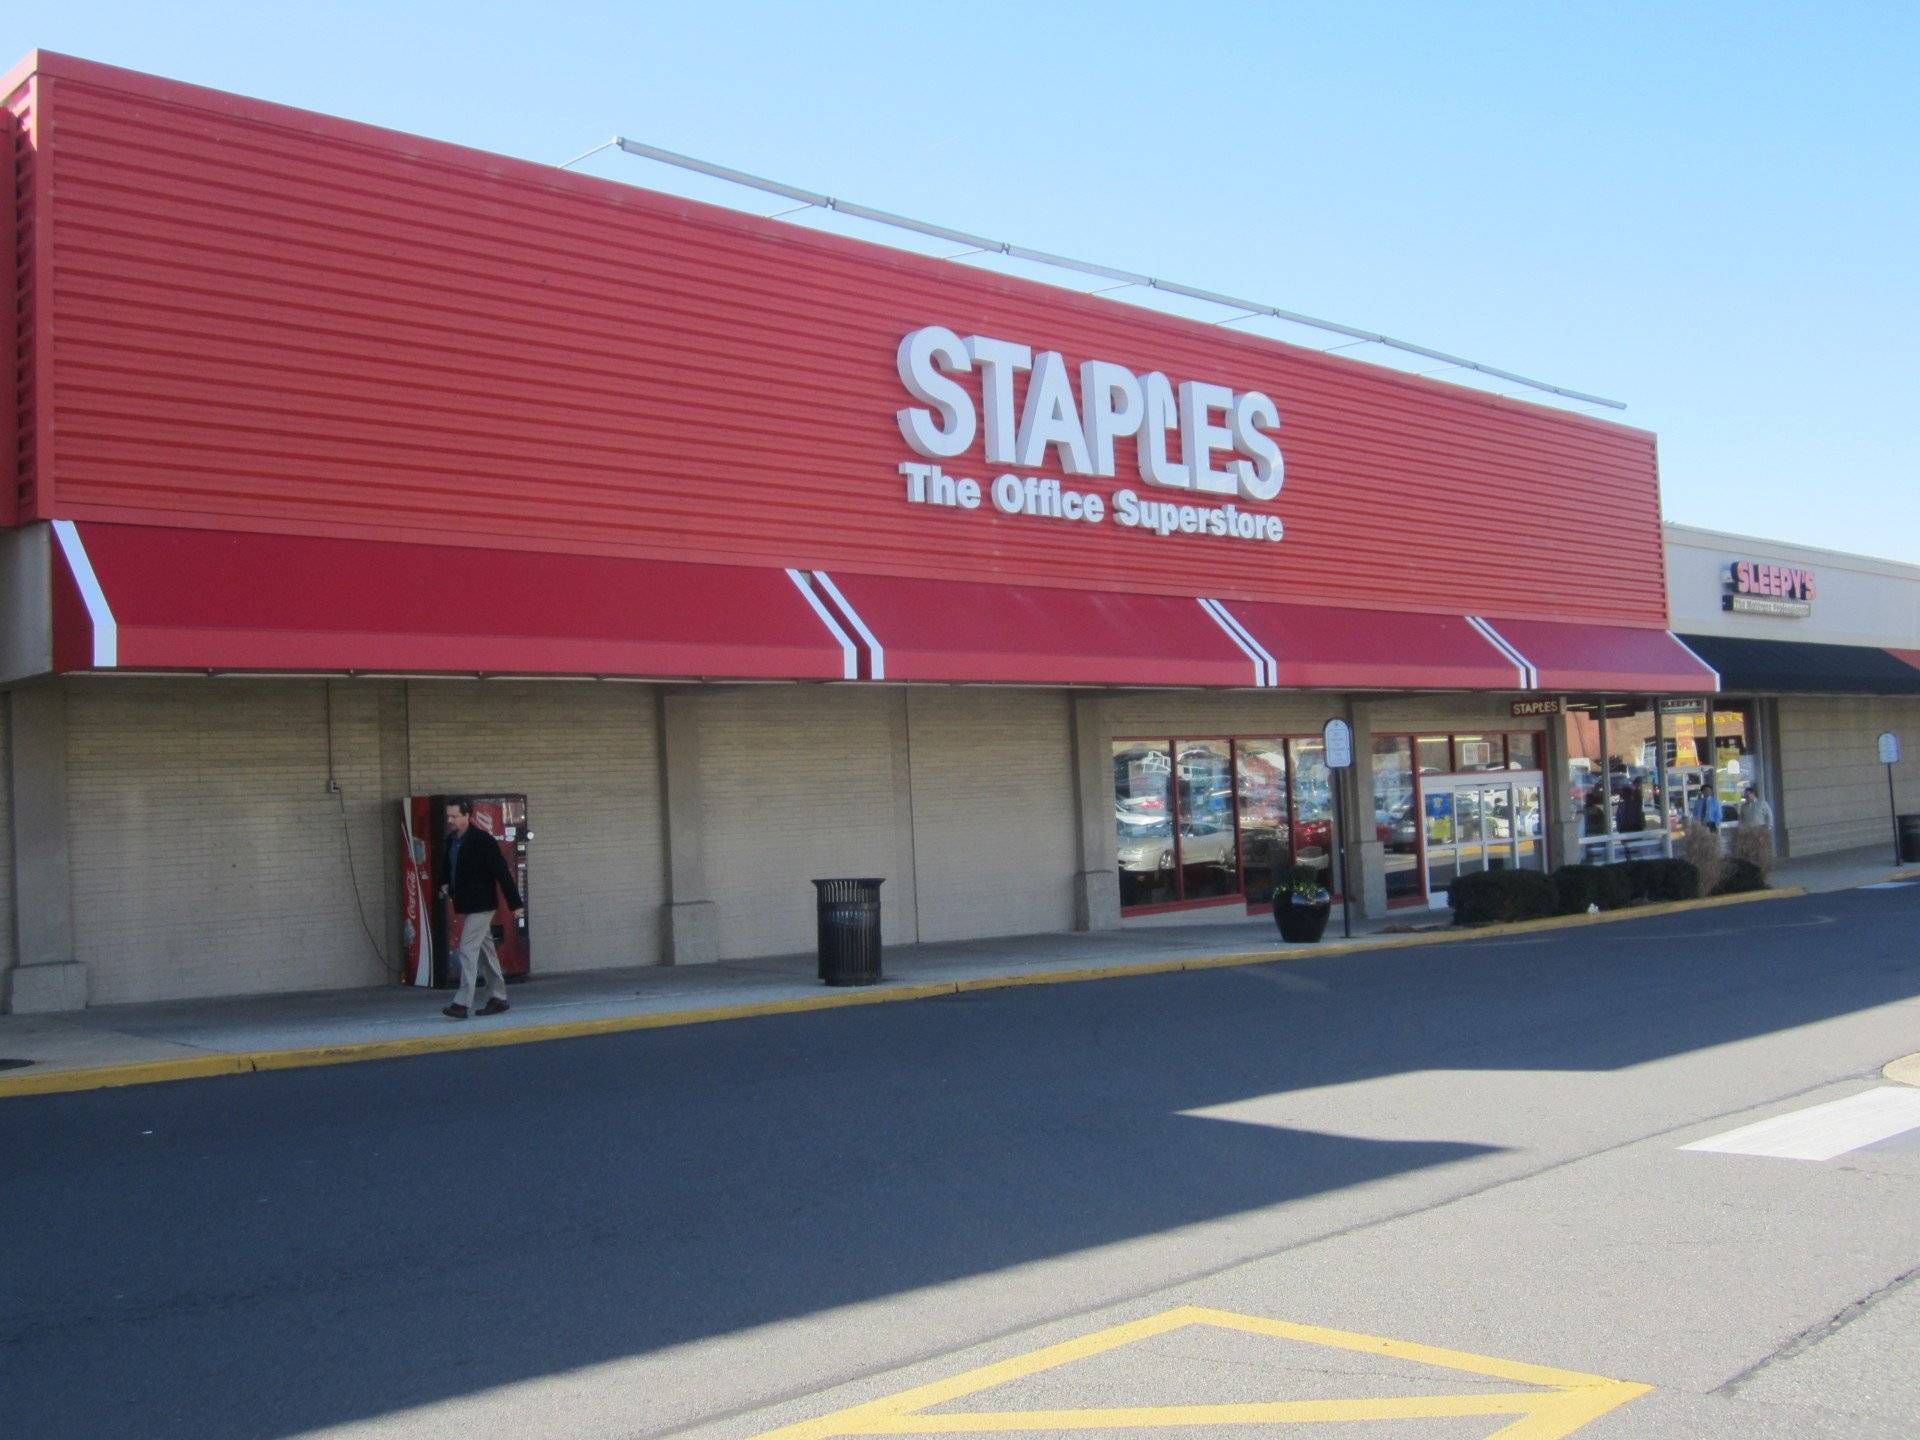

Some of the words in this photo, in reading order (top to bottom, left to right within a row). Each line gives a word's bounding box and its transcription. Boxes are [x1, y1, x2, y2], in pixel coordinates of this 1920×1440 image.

[897, 325, 1284, 500] STAPLES
[898, 462, 981, 509] The
[991, 473, 1105, 523] Office
[1112, 489, 1284, 542] Superstore
[1733, 560, 1816, 602] SLEEPY'S
[1513, 701, 1558, 715] STAPLES
